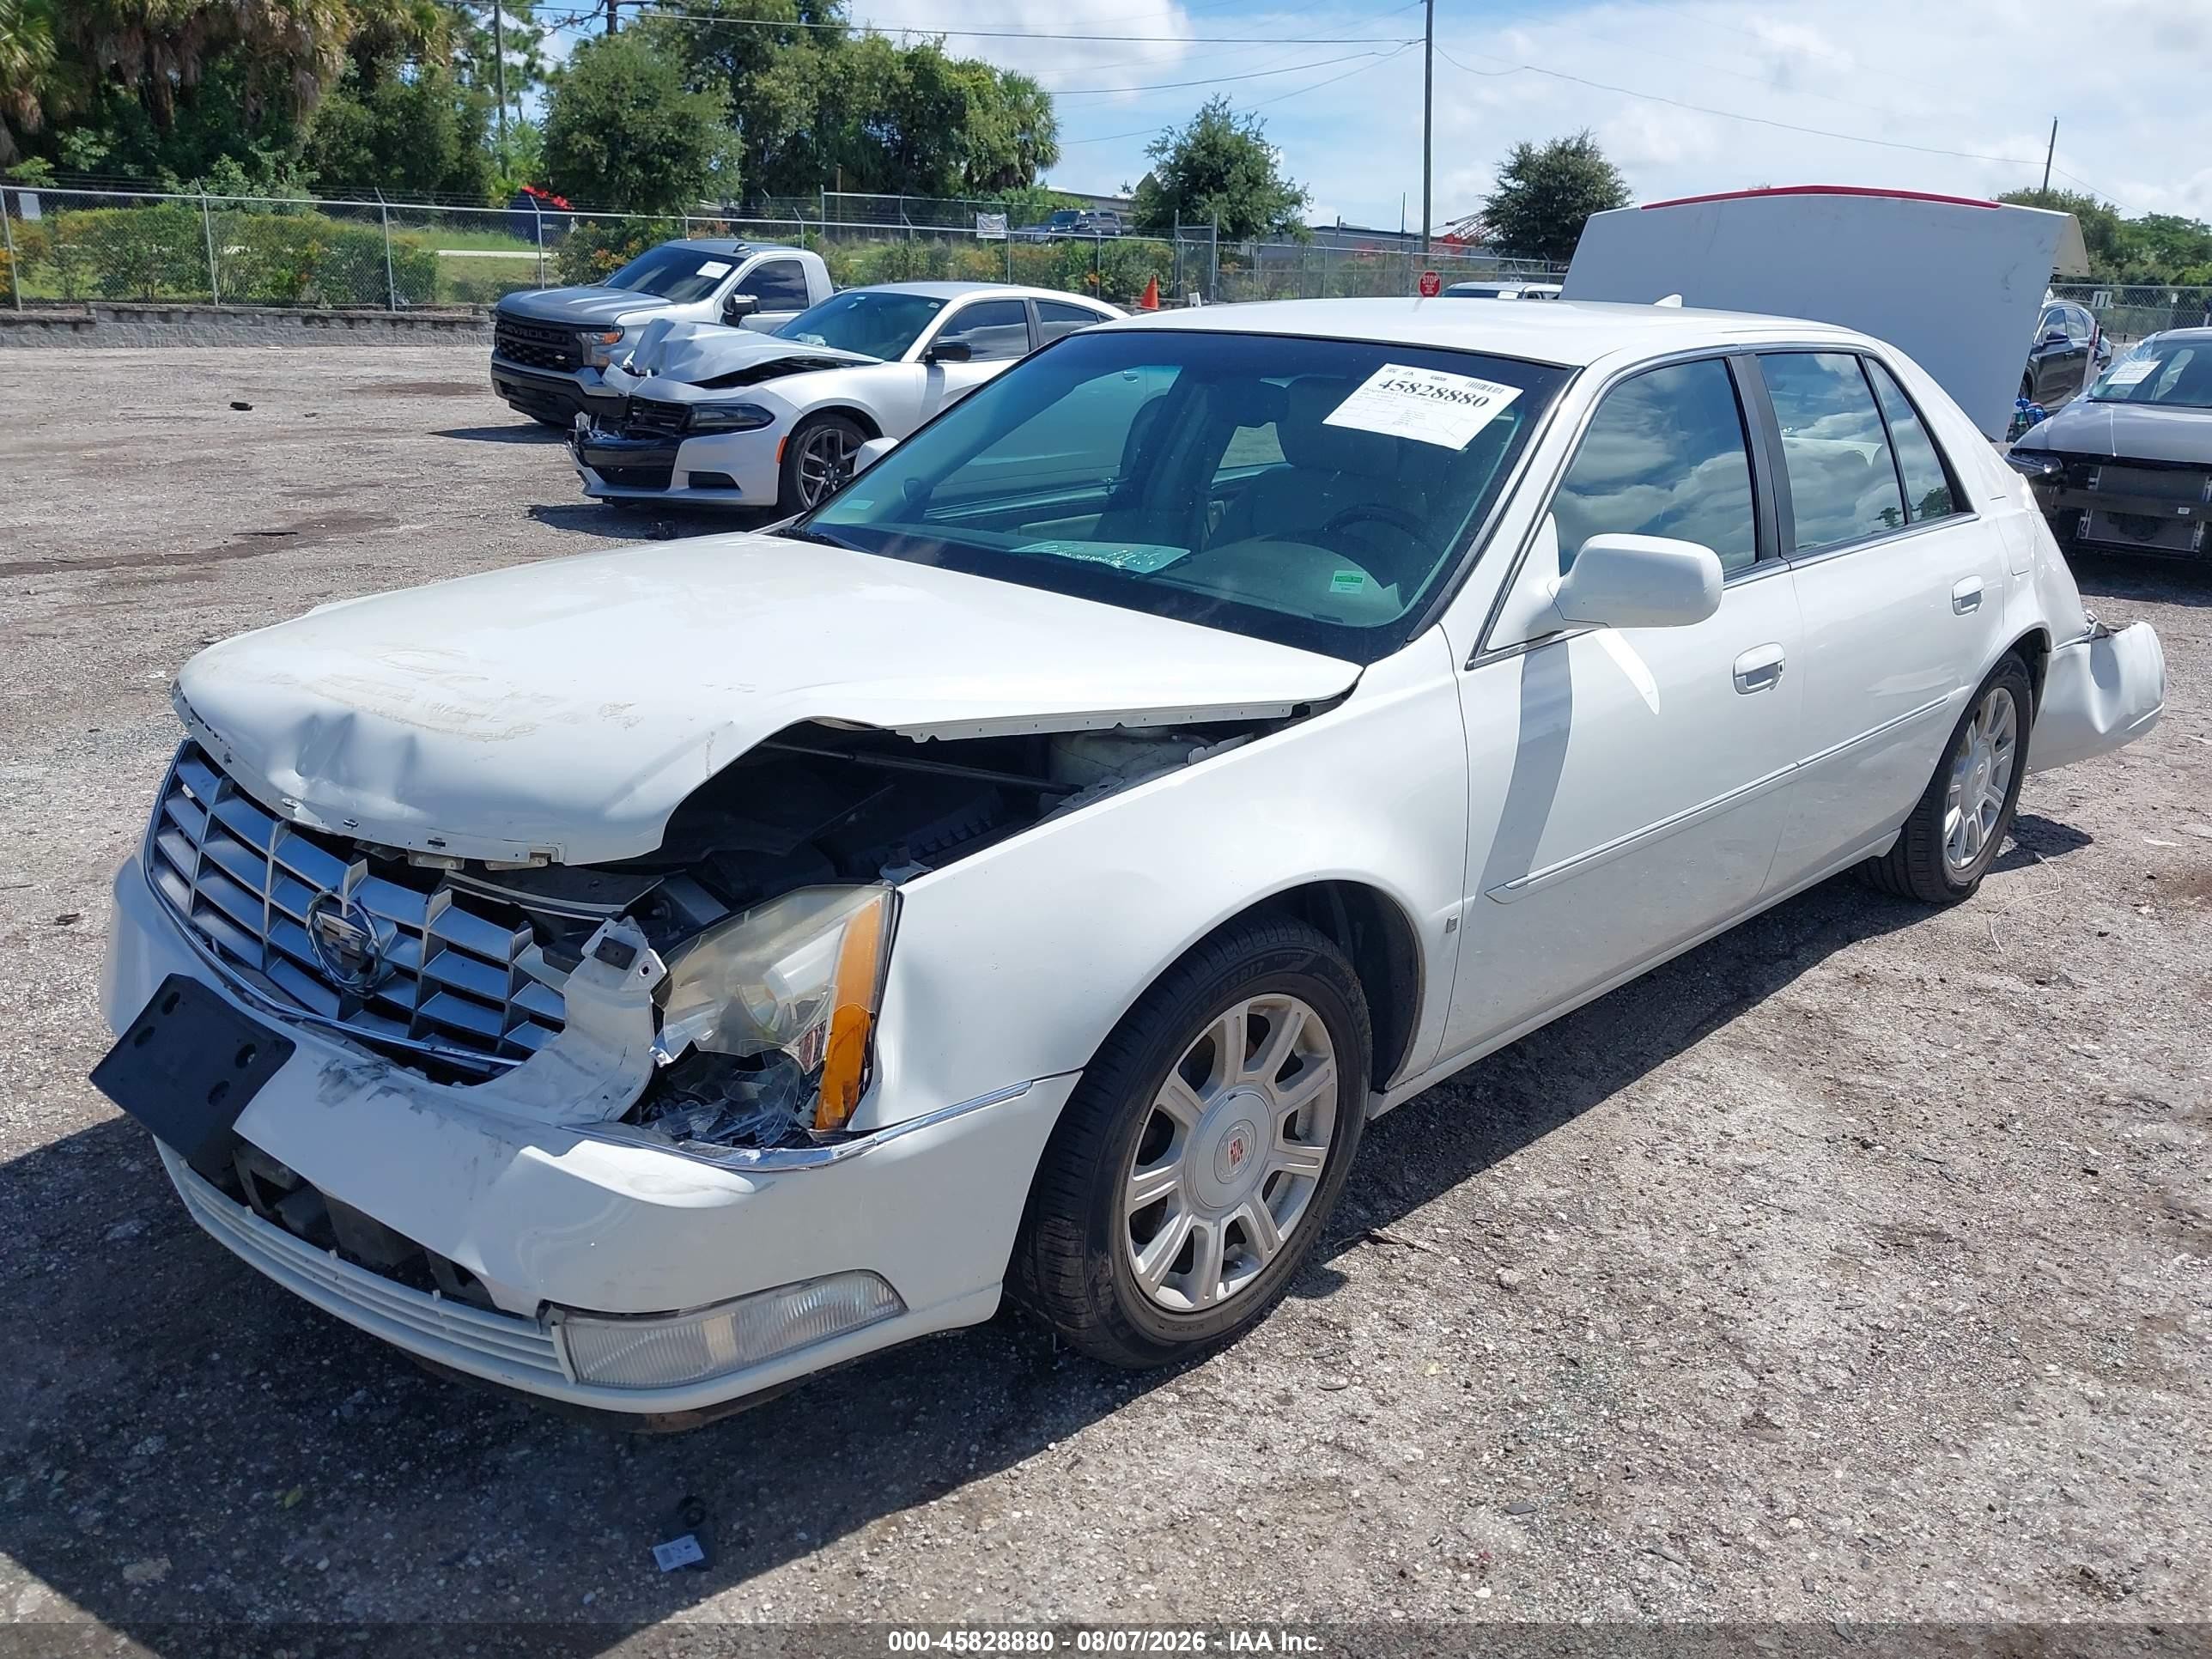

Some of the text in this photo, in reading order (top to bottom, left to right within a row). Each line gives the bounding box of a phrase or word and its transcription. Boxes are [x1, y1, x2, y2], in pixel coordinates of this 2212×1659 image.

[1422, 275, 1437, 284] STOP
[2095, 294, 2108, 307] 11
[1377, 378, 1490, 408] 45828880
